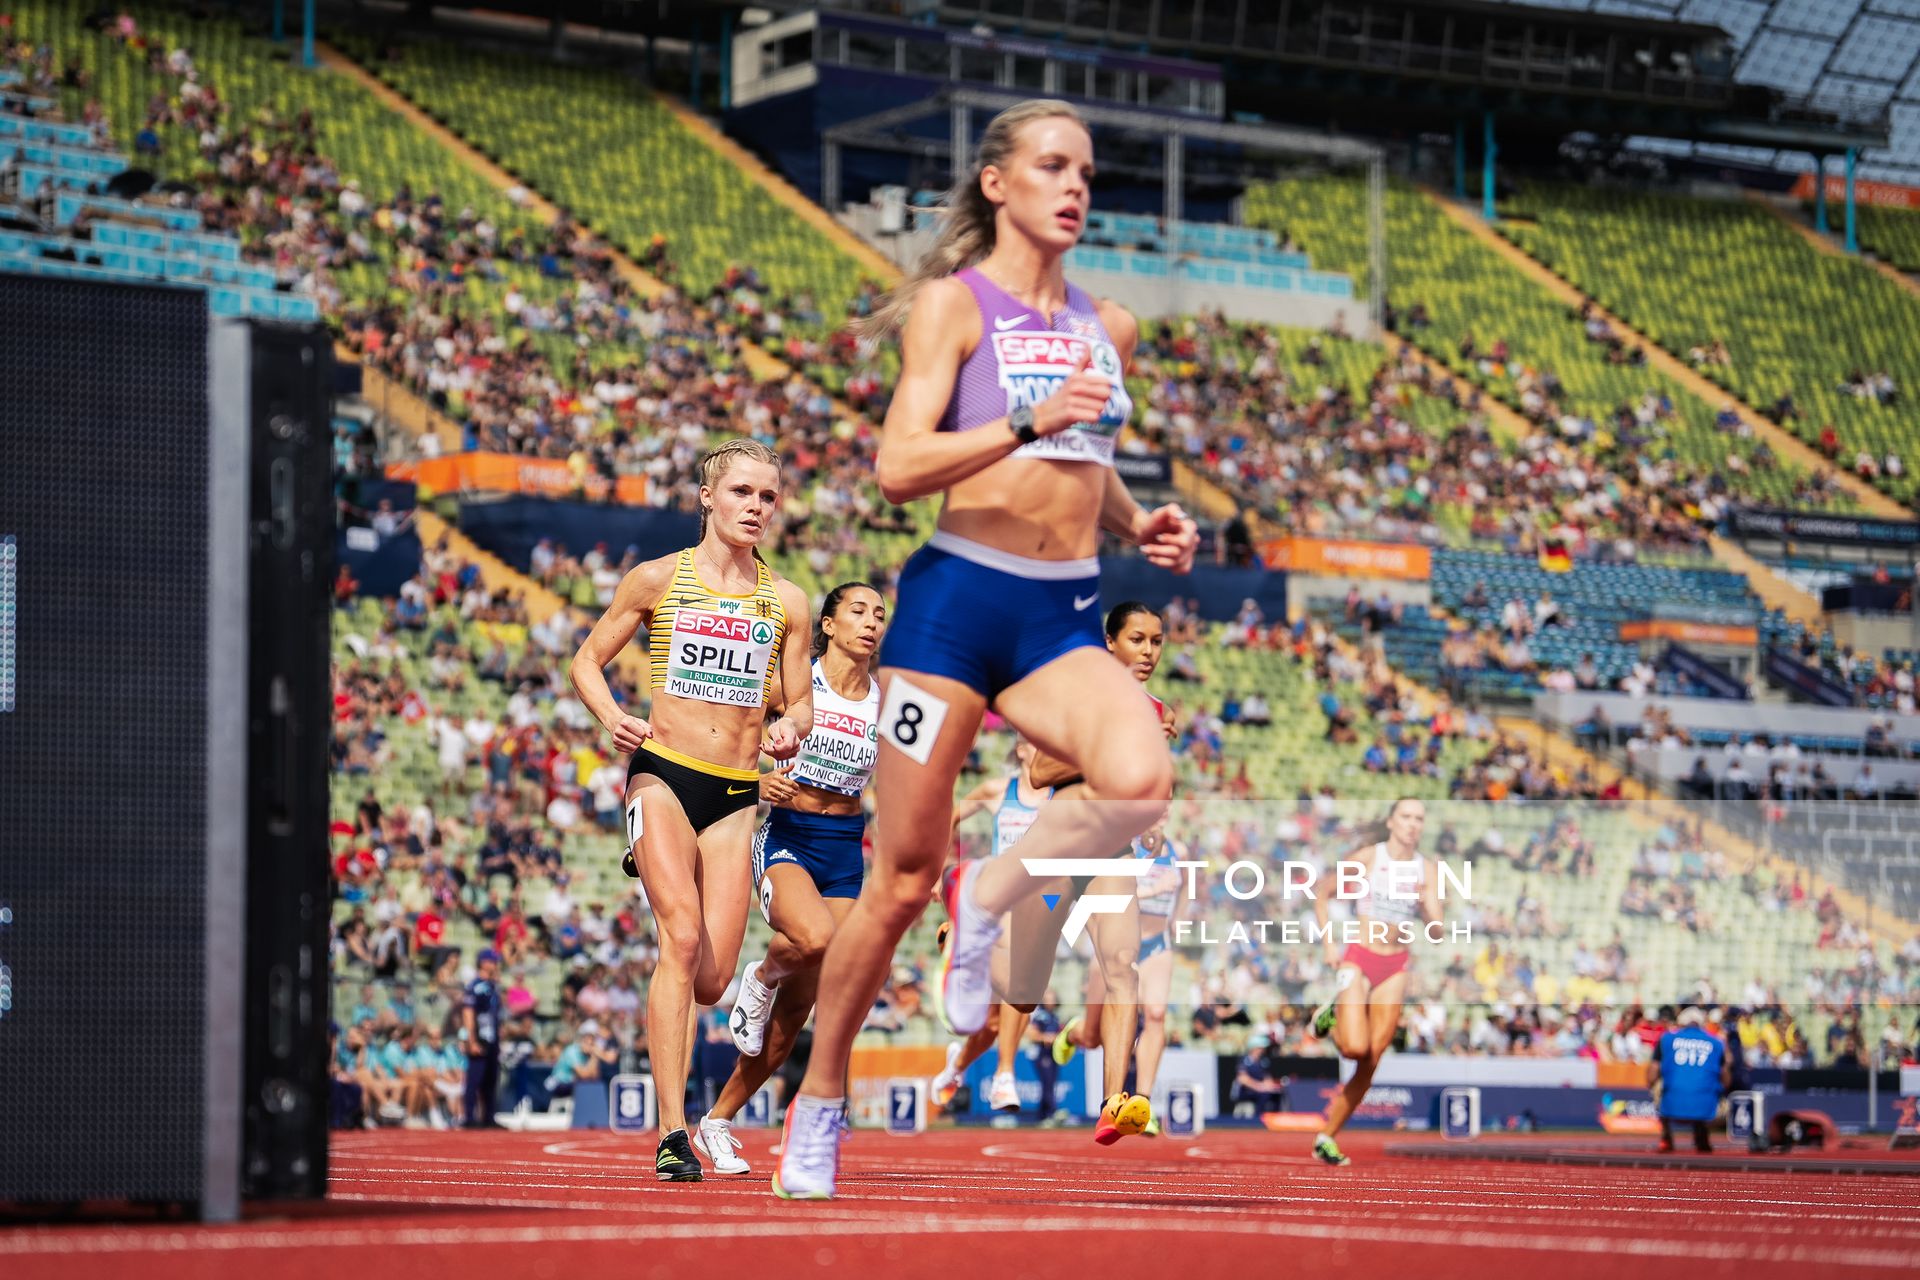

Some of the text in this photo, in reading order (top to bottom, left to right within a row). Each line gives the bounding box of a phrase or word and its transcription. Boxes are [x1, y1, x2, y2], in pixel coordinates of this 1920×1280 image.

[678, 613, 748, 638] SPAR
[680, 643, 757, 674] SPILL
[695, 672, 713, 682] RUN
[671, 680, 758, 703] MUNICH 2022
[814, 712, 864, 736] SPAR
[894, 702, 923, 745] 8
[800, 762, 863, 788] MUNICH 2022
[821, 760, 836, 770] RUN
[628, 806, 636, 840] 7
[620, 1089, 642, 1118] 8
[894, 1092, 913, 1121] 7
[1450, 1101, 1468, 1127] 5
